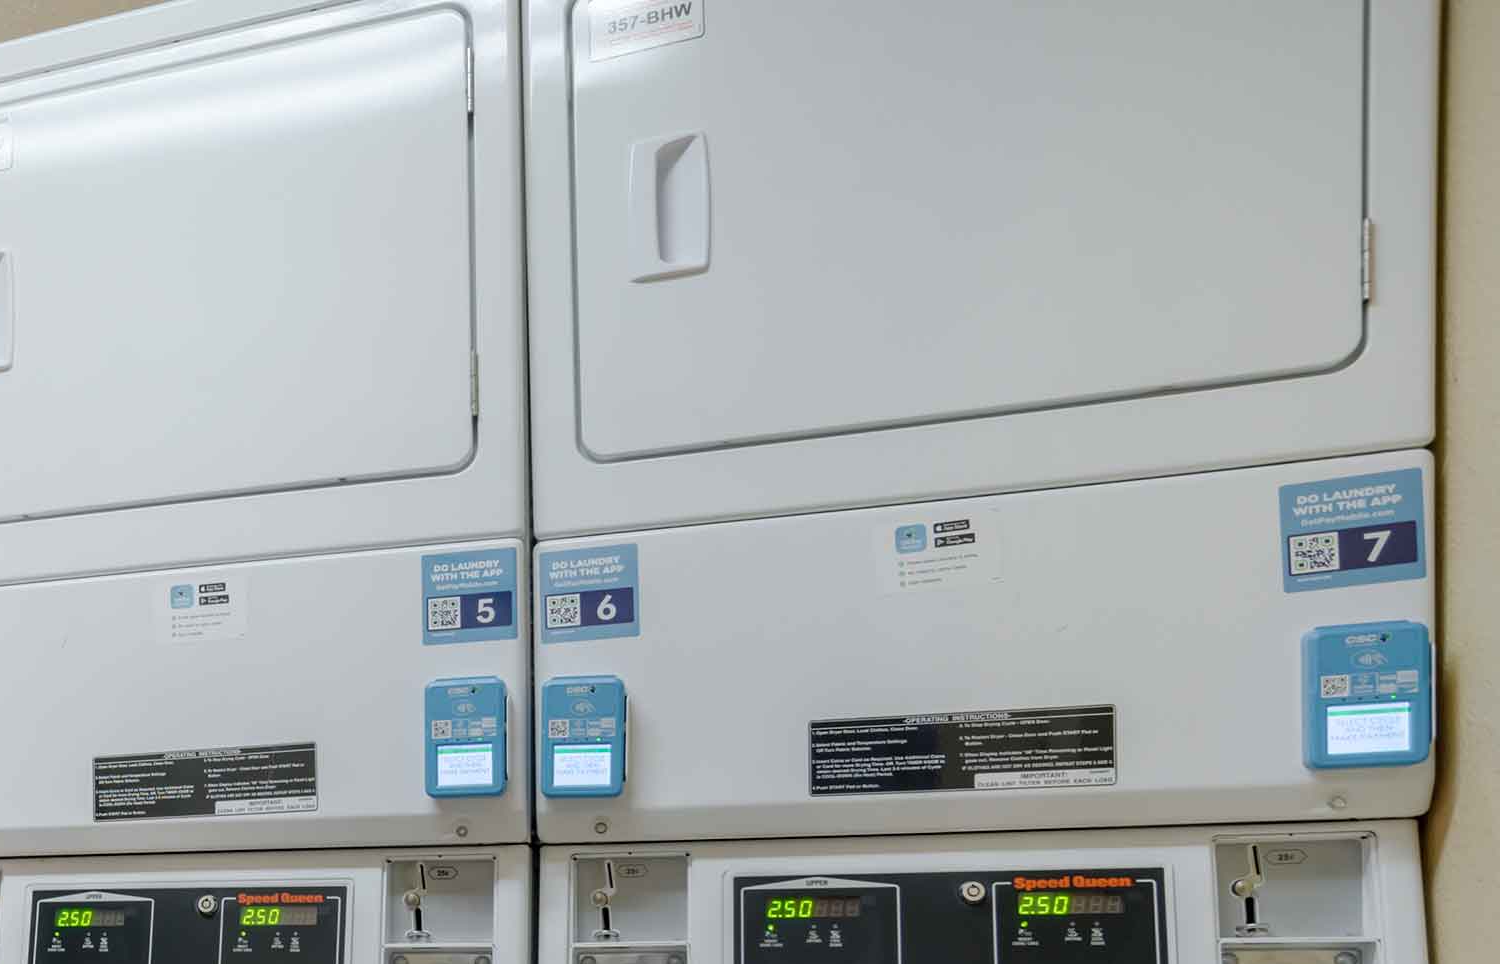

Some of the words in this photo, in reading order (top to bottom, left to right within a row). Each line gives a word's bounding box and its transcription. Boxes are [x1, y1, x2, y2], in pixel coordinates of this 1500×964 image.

[608, 2, 692, 34] 357-BHW
[1296, 495, 1318, 505] DO
[1323, 484, 1396, 502] LAUNDRY
[1293, 503, 1332, 516] WITH
[1336, 499, 1366, 511] THE
[1370, 494, 1402, 507] APP
[1363, 530, 1391, 562] 7
[433, 564, 449, 573] DO
[451, 560, 500, 571] LAUNDRY
[460, 570, 479, 579] THE
[482, 568, 503, 577] APP
[549, 570, 577, 579] WITH
[580, 568, 600, 576] THE
[476, 598, 495, 623] 5
[596, 594, 617, 621] 6
[1013, 876, 1070, 890] Speed
[1072, 875, 1132, 888] Queen
[238, 893, 279, 904] Speed
[281, 893, 324, 903] Queen
[1018, 896, 1069, 915] 2.50
[243, 908, 280, 925] 2.50
[767, 900, 813, 918] 2.50
[58, 911, 93, 927] 2.50
